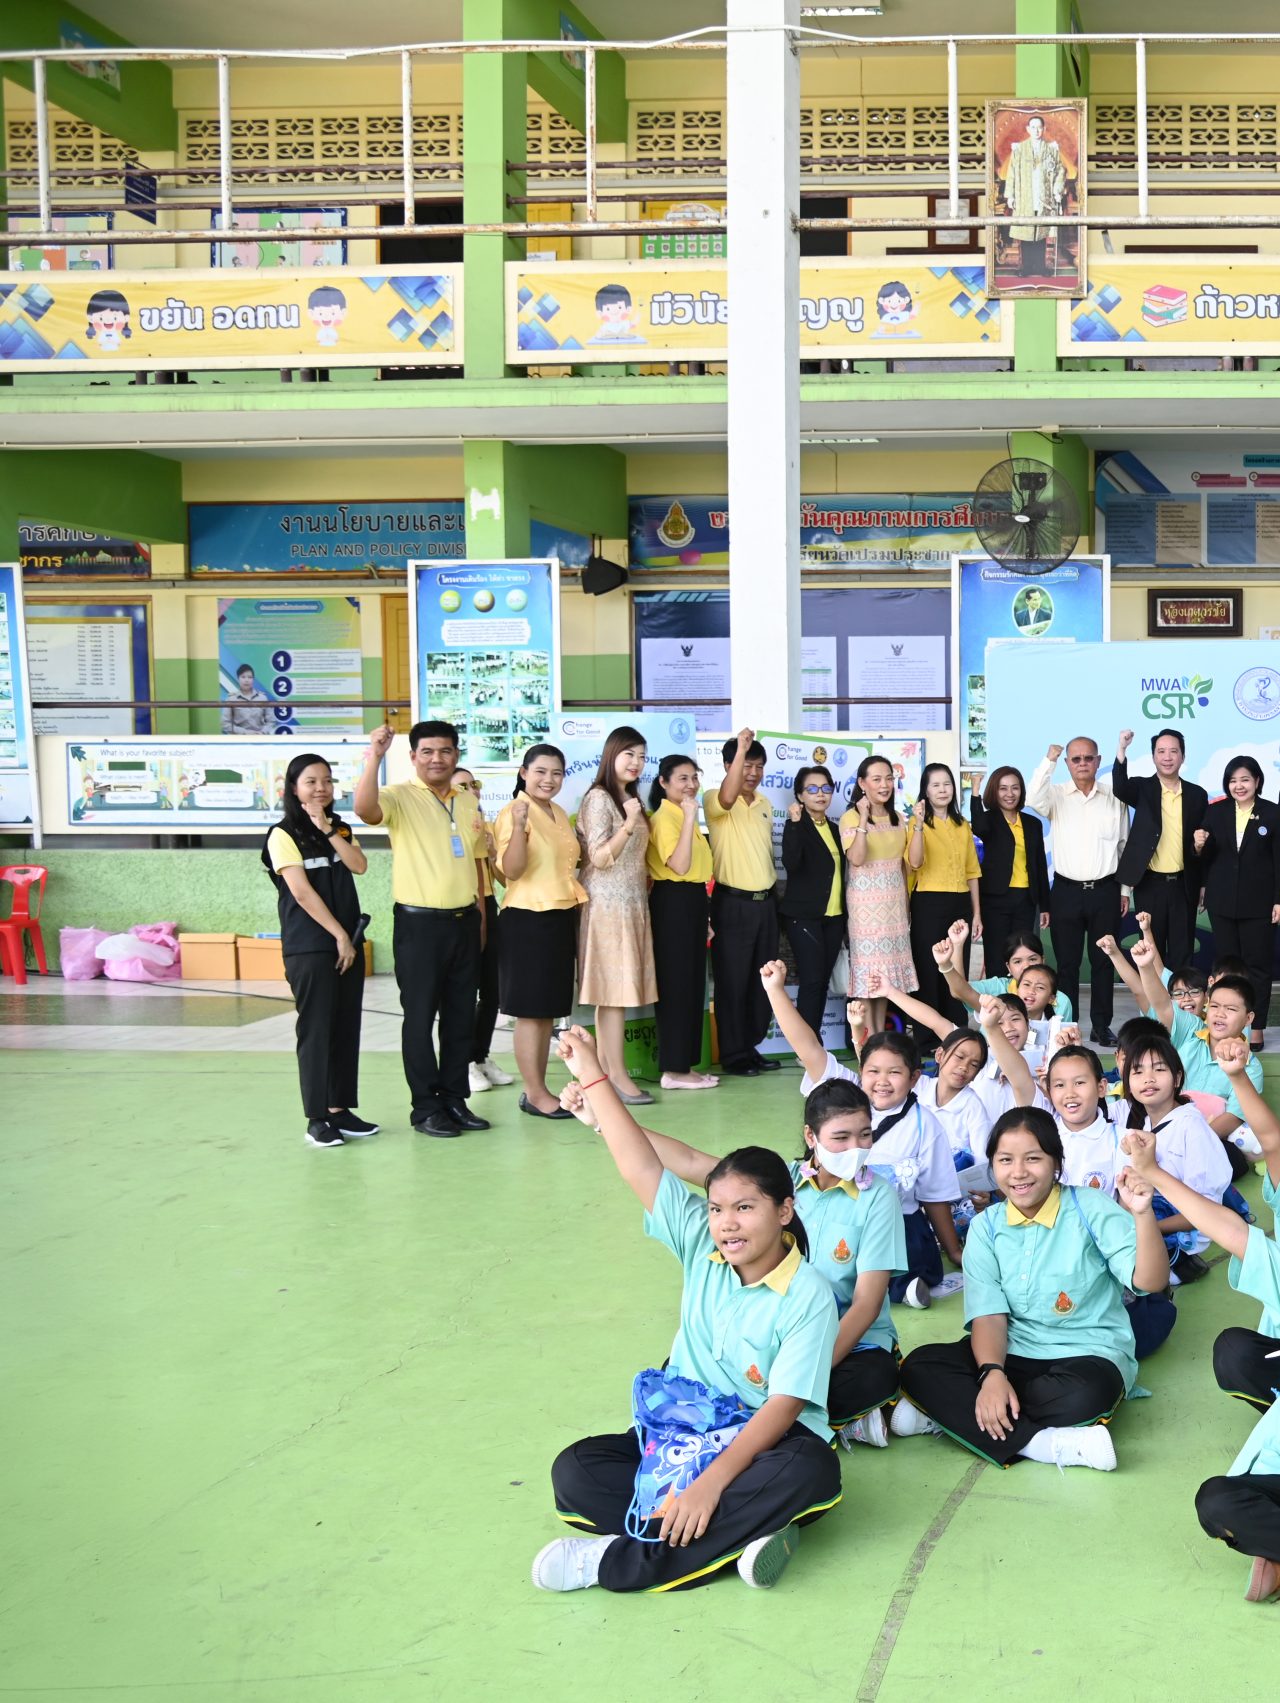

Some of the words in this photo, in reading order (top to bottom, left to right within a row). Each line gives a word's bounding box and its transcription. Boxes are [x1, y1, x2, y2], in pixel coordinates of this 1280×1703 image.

[139, 298, 204, 331] ขยัน
[212, 304, 300, 330] อดทน
[291, 544, 328, 557] PLAN
[333, 544, 364, 556] AND
[370, 543, 422, 556] POLICY
[427, 543, 466, 555] DIVIS
[1141, 678, 1181, 691] MWA
[1142, 693, 1195, 720] CSR
[126, 750, 140, 758] your
